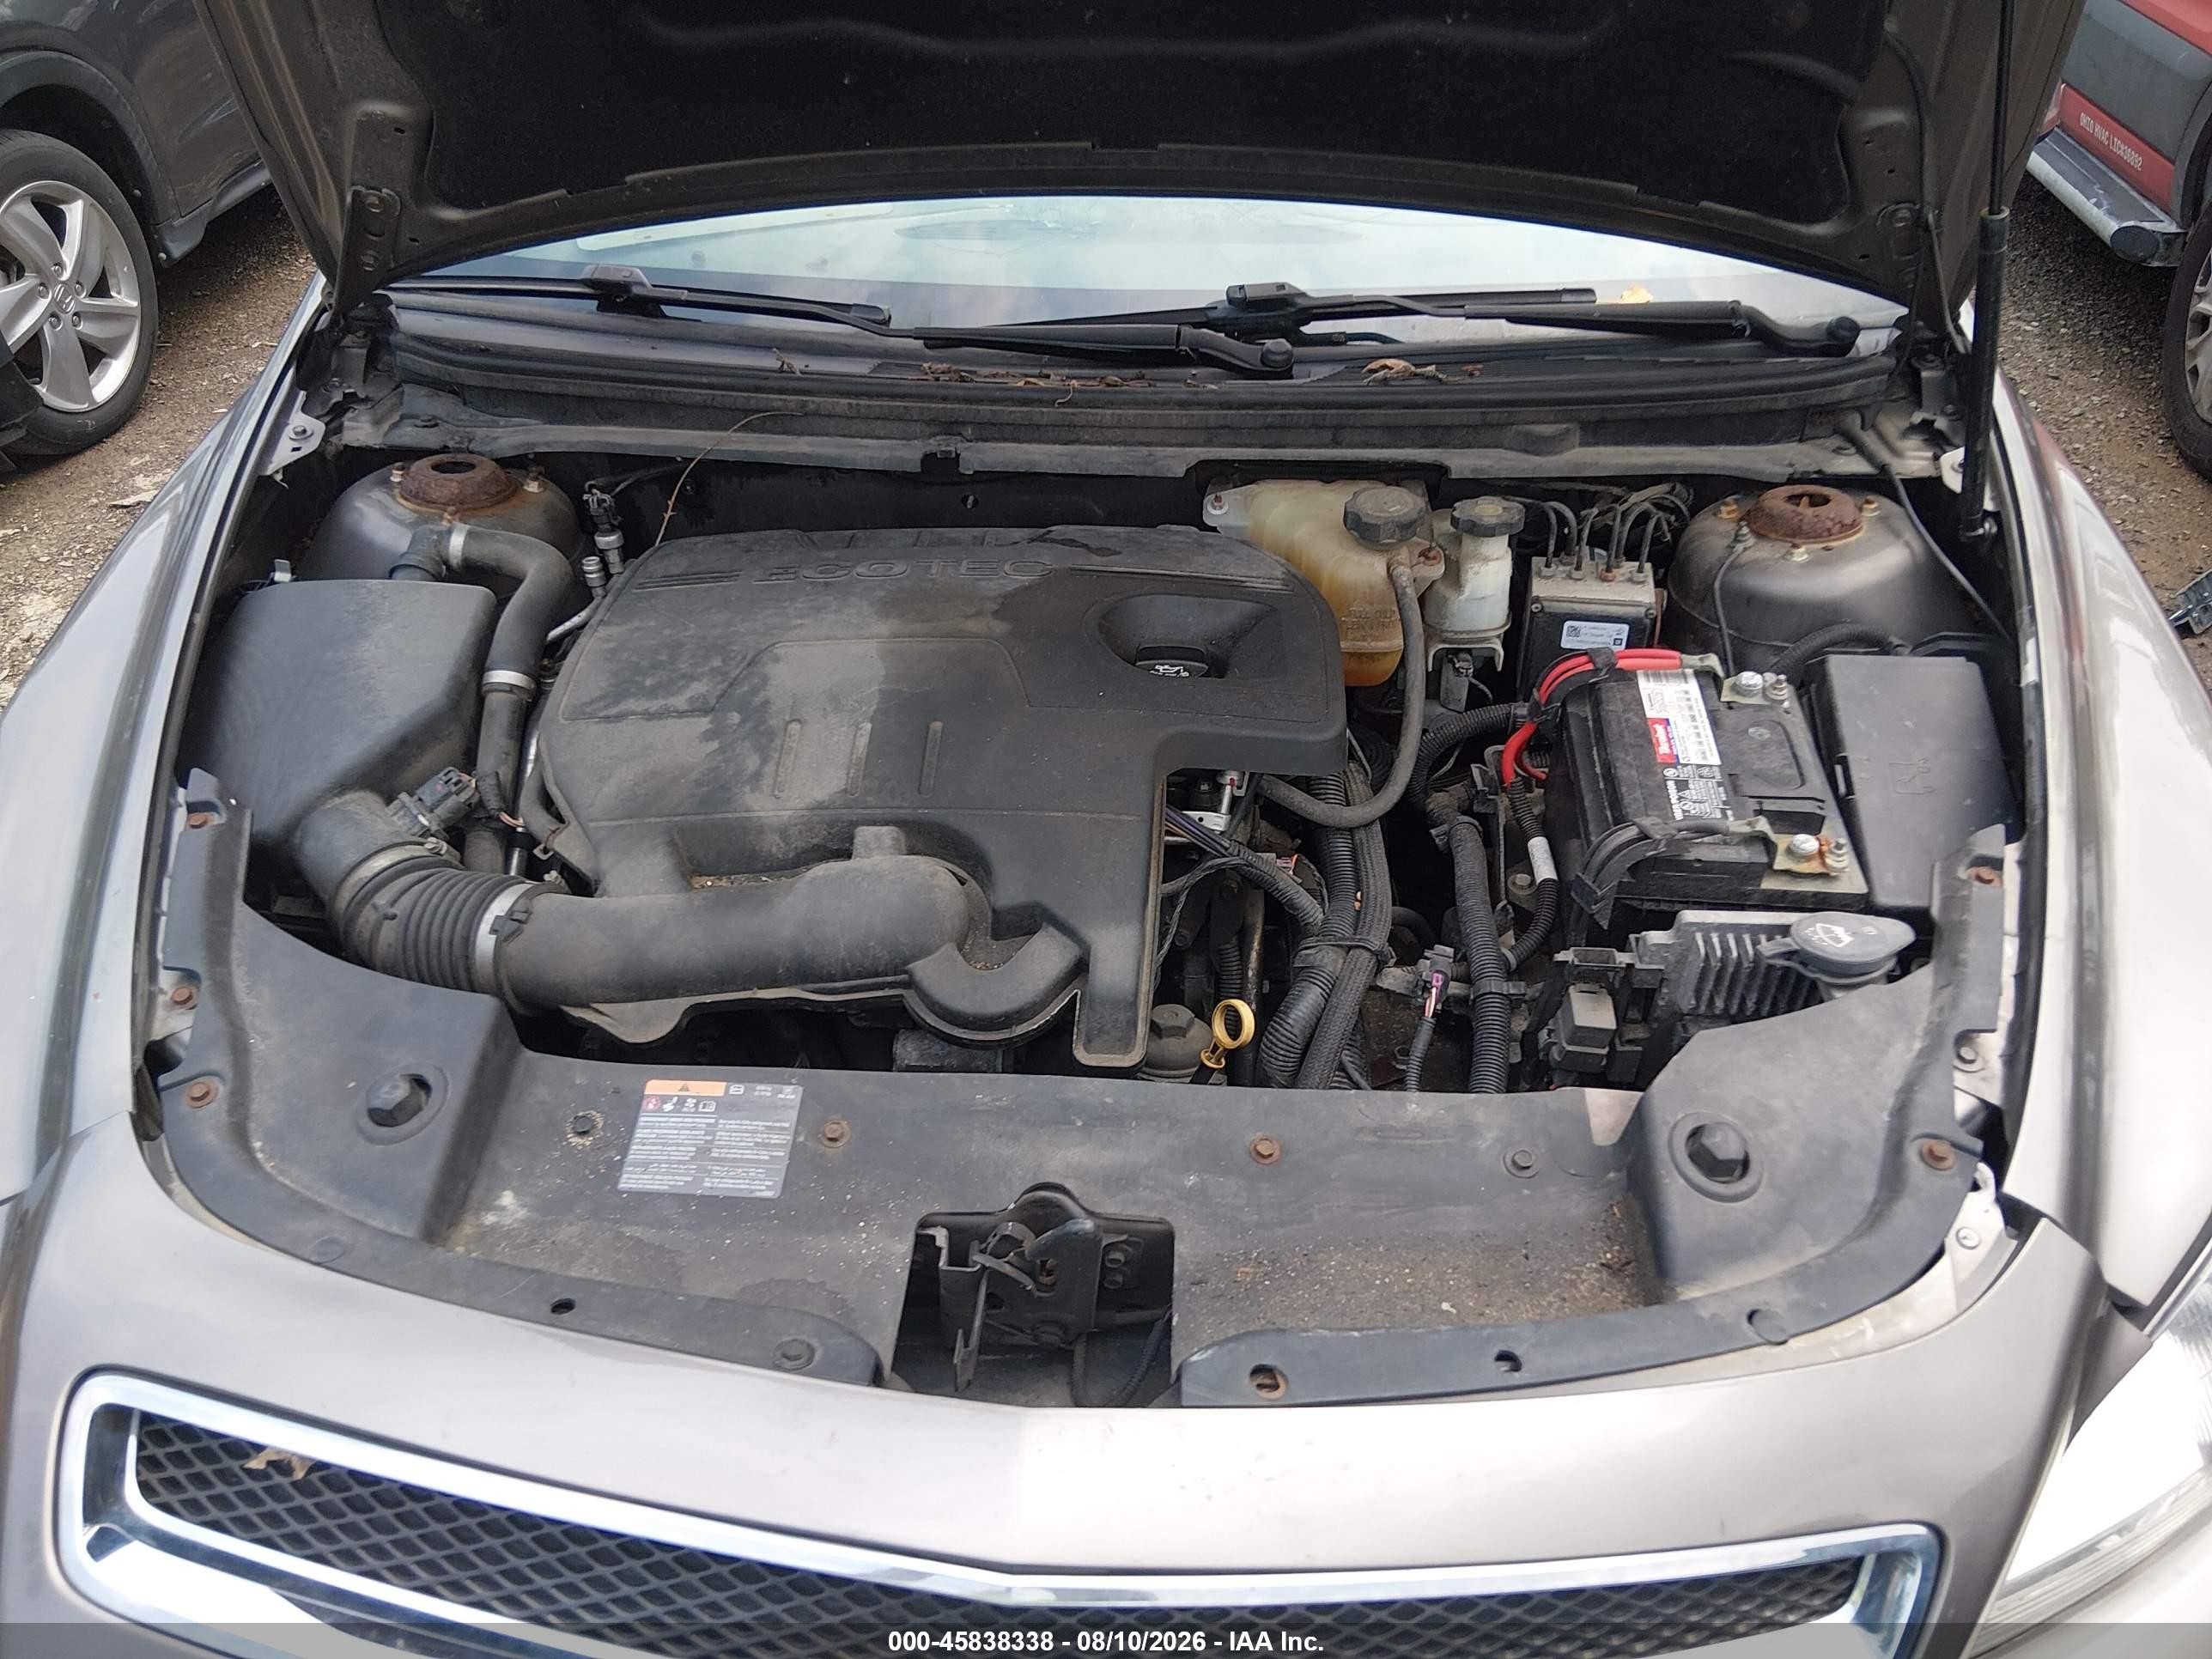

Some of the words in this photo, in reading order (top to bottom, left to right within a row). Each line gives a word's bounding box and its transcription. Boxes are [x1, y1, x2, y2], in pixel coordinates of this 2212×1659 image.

[2080, 112, 2094, 133] OHIO
[2094, 123, 2109, 145] HVAC
[753, 558, 1056, 585] ECOTEC
